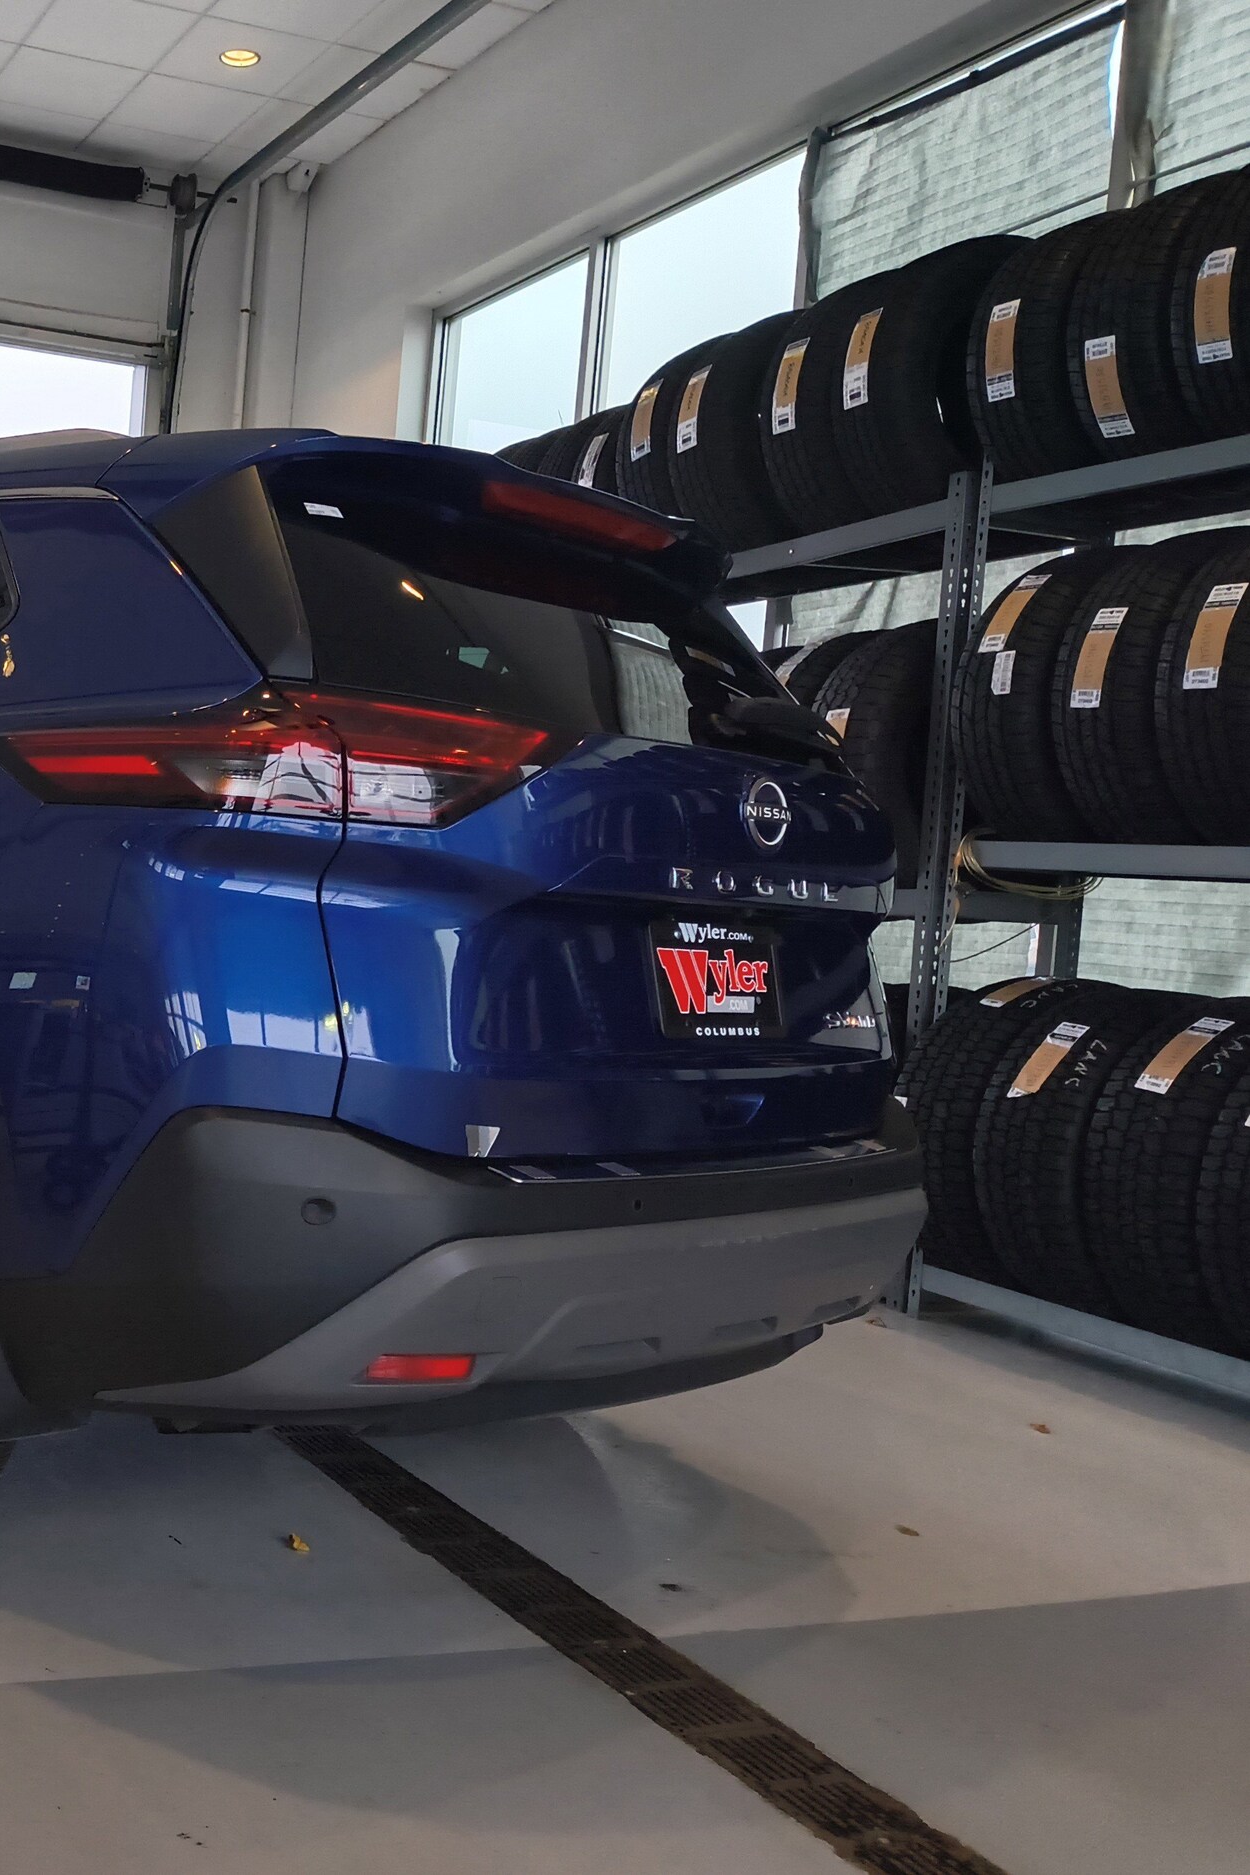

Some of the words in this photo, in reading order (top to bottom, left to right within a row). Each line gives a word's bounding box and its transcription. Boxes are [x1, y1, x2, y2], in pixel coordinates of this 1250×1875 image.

[746, 805, 791, 821] NISSAN
[669, 866, 838, 902] ROGUE
[656, 947, 768, 1014] Wyler
[695, 1027, 760, 1036] COLUMBUS
